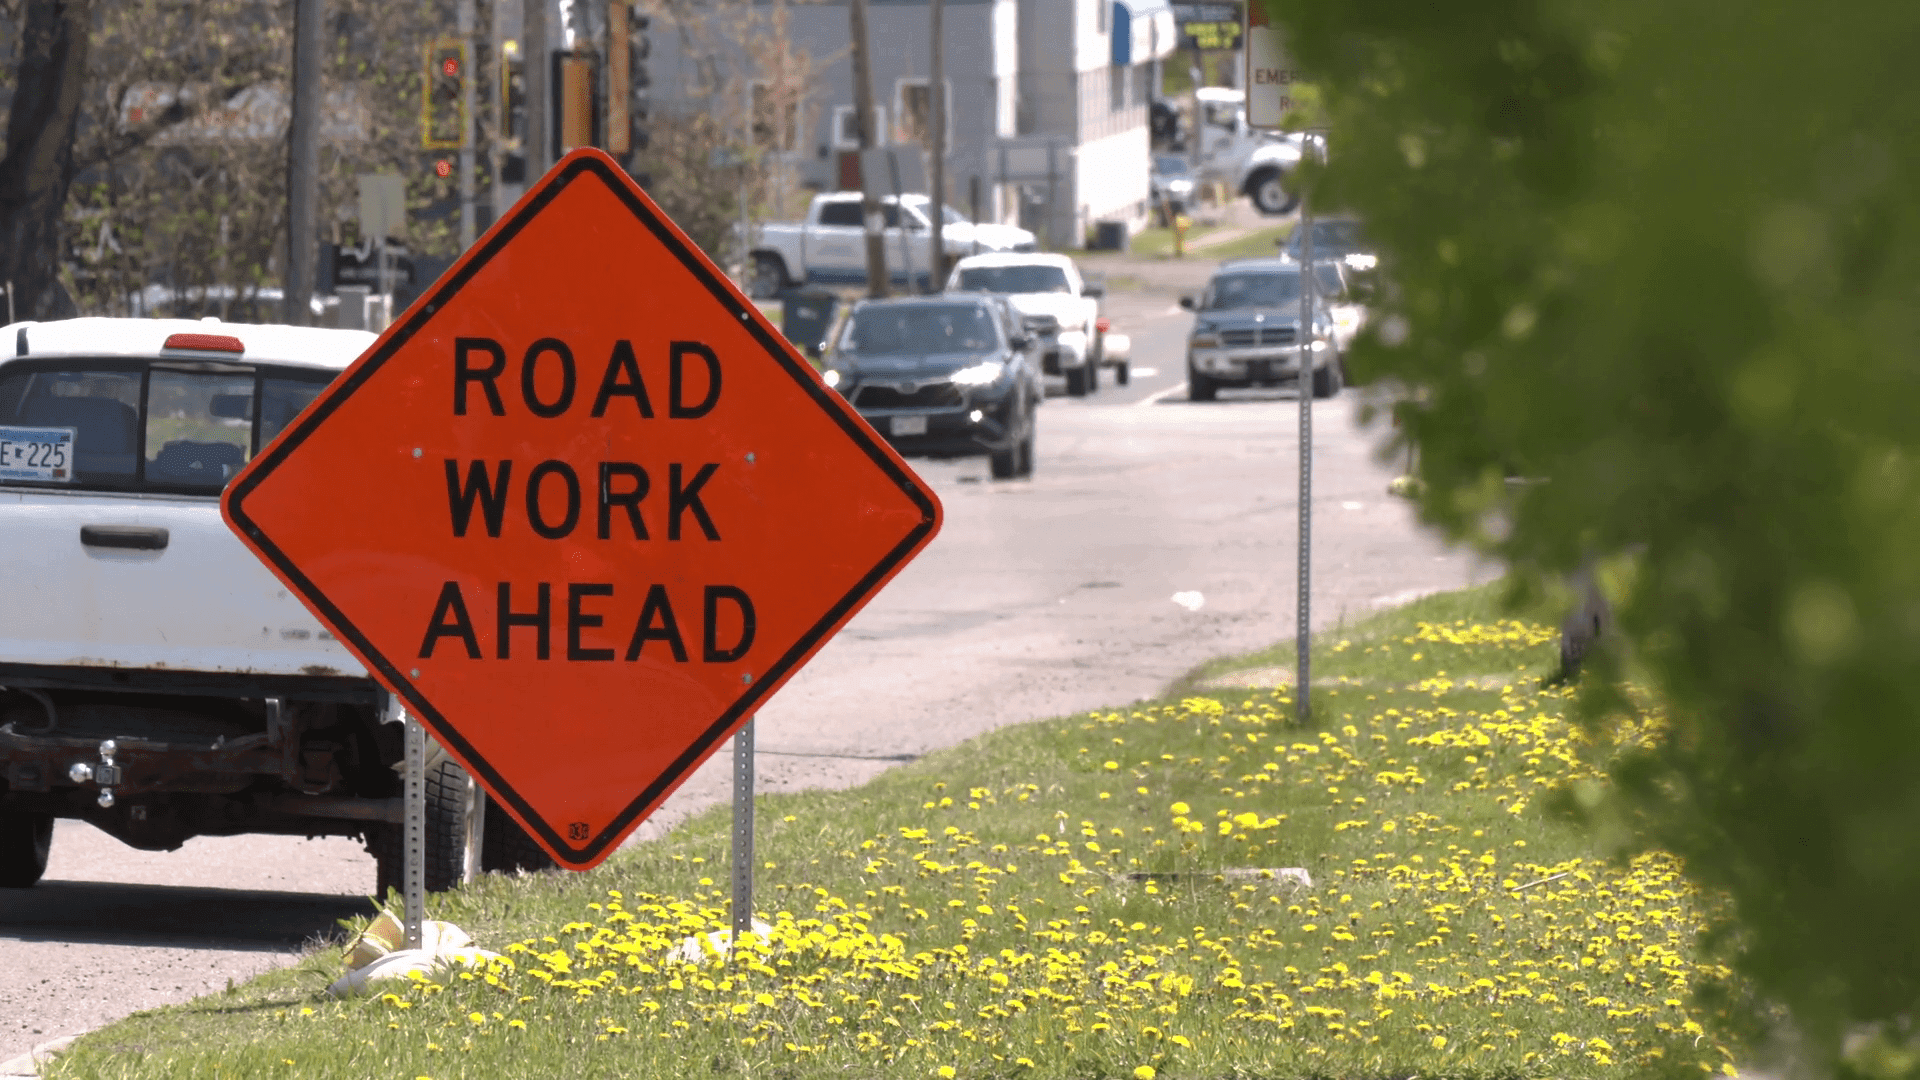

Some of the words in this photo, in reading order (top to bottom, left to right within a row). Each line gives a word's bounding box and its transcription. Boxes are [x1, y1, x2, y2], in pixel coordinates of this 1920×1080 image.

[453, 337, 723, 420] ROAD
[444, 459, 721, 541] WORK
[418, 581, 757, 663] AHEAD
